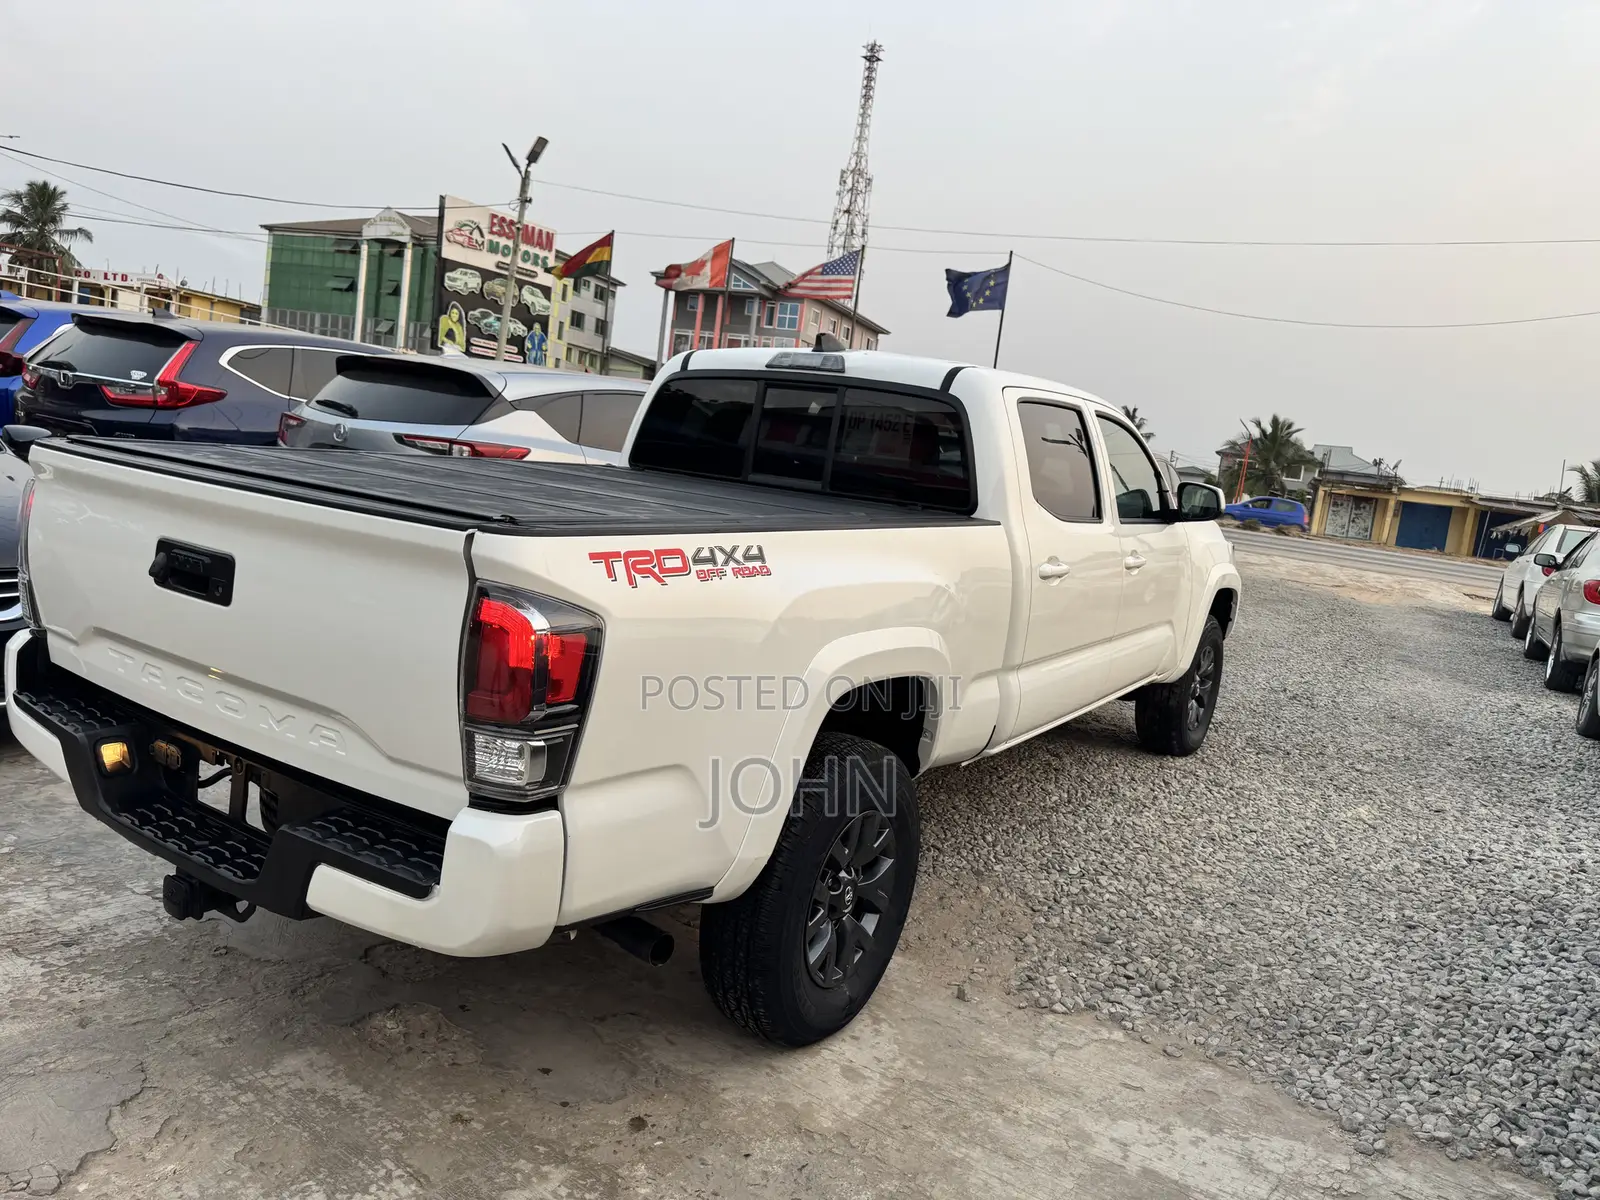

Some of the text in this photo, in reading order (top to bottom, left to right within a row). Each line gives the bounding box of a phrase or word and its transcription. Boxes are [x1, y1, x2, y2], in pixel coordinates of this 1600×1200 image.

[489, 213, 555, 252] ESSMAN
[487, 239, 549, 269] MOORS
[104, 272, 133, 282] LTD.
[588, 548, 692, 588] TRD
[696, 565, 771, 582] OFF ROAD
[107, 647, 347, 756] TACOMA
